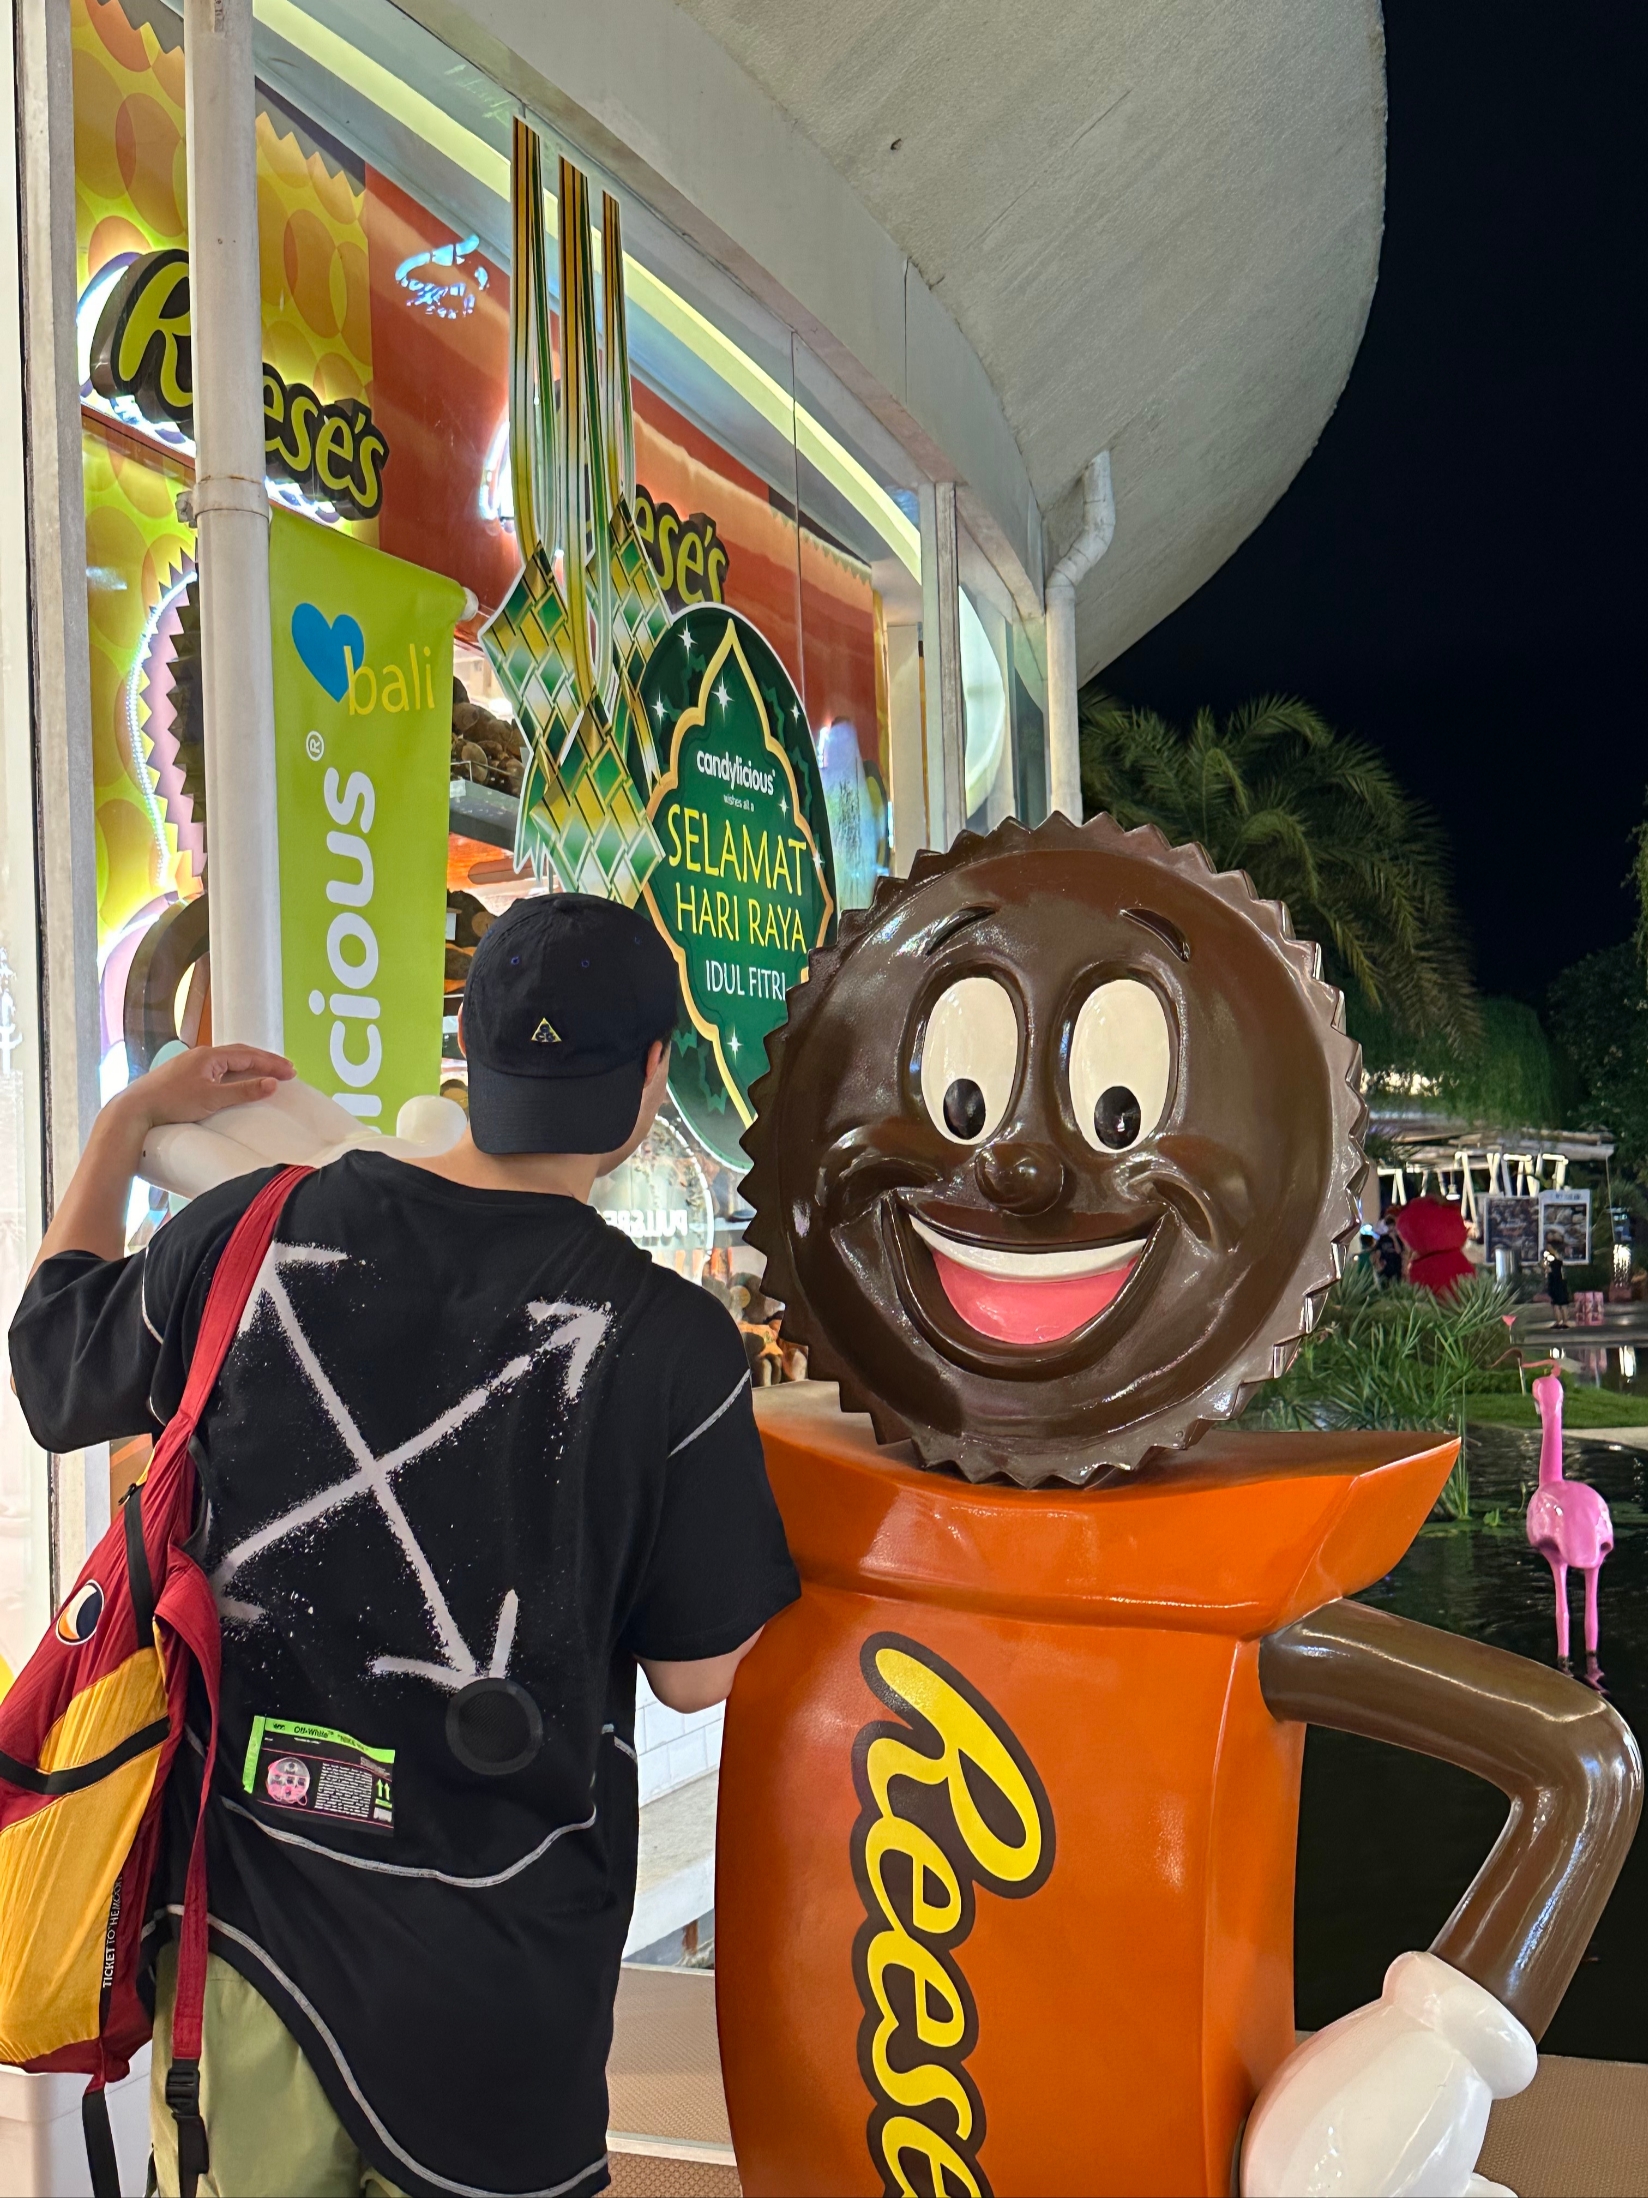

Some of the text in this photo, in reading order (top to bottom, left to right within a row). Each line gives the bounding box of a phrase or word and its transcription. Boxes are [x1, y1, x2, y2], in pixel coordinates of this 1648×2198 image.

[118, 261, 386, 509] Rese's
[342, 642, 436, 717] bali
[667, 803, 807, 897] SELAMAT
[675, 882, 807, 954] HARI RAYA
[705, 959, 786, 1001] IDUL FITRI
[102, 1946, 116, 1988] TICKET
[106, 1929, 116, 1946] TO
